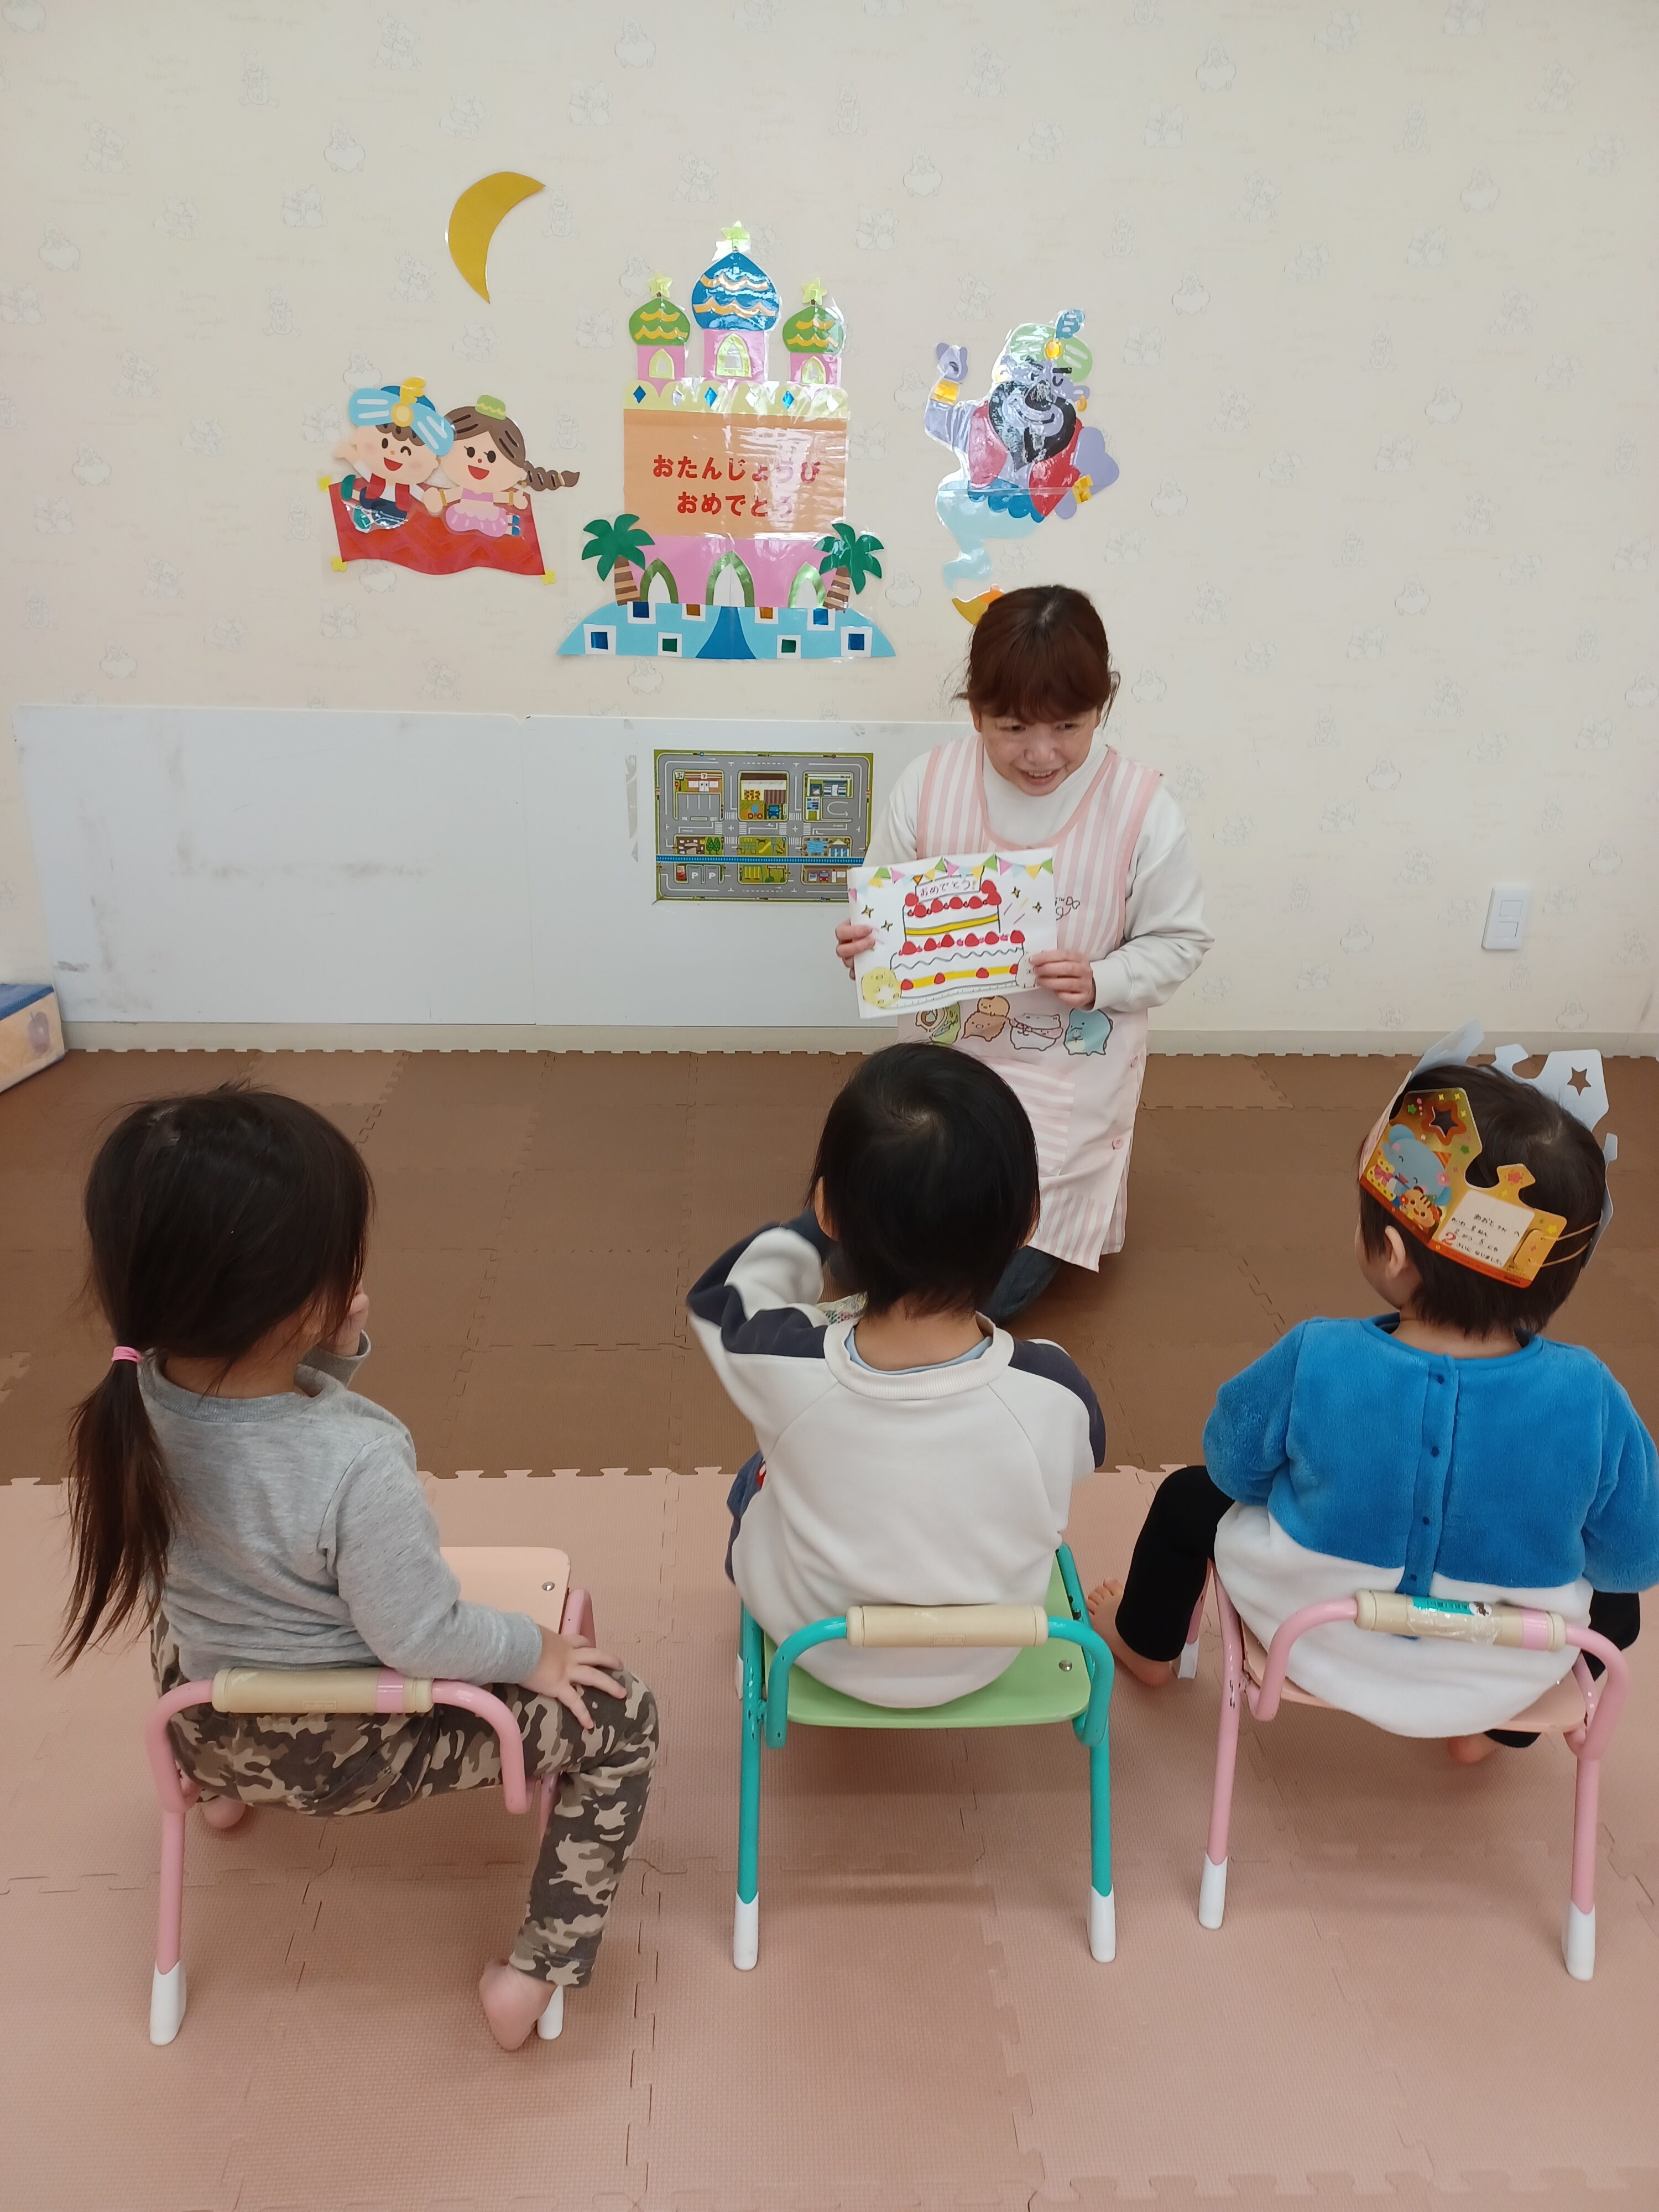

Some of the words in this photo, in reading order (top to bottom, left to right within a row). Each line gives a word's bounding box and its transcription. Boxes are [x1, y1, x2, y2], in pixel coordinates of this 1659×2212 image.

[653, 454, 821, 484] おたんじょうび
[677, 491, 792, 518] おめでとう
[1441, 1231, 1457, 1245] 2
